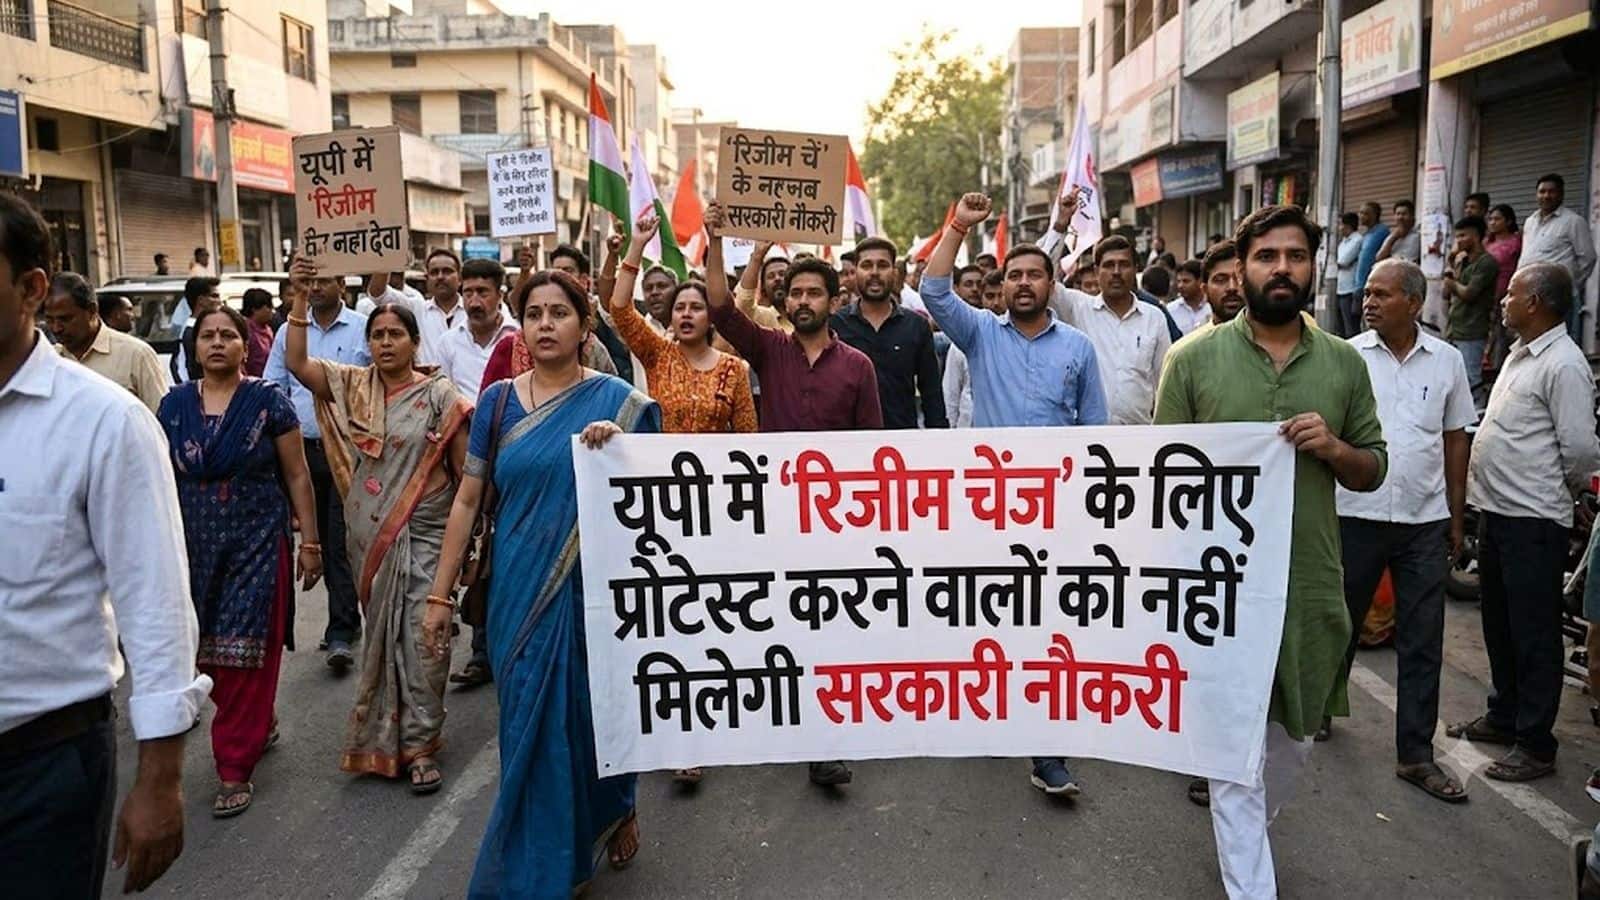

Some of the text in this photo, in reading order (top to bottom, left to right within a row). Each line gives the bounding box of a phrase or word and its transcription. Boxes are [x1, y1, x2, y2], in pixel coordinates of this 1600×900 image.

[299, 140, 346, 185] यूपी
[352, 136, 375, 172] में
[732, 166, 752, 195] के
[727, 201, 837, 234] सरकारी नौकरी
[609, 442, 1261, 556] यूपी में ‘रिजीम चेंज’ के लिए
[608, 543, 1248, 647] प्रोटेस्ट करने वालों को नहीं
[633, 633, 1188, 735] मिलेगी सरकारी नौकरी
